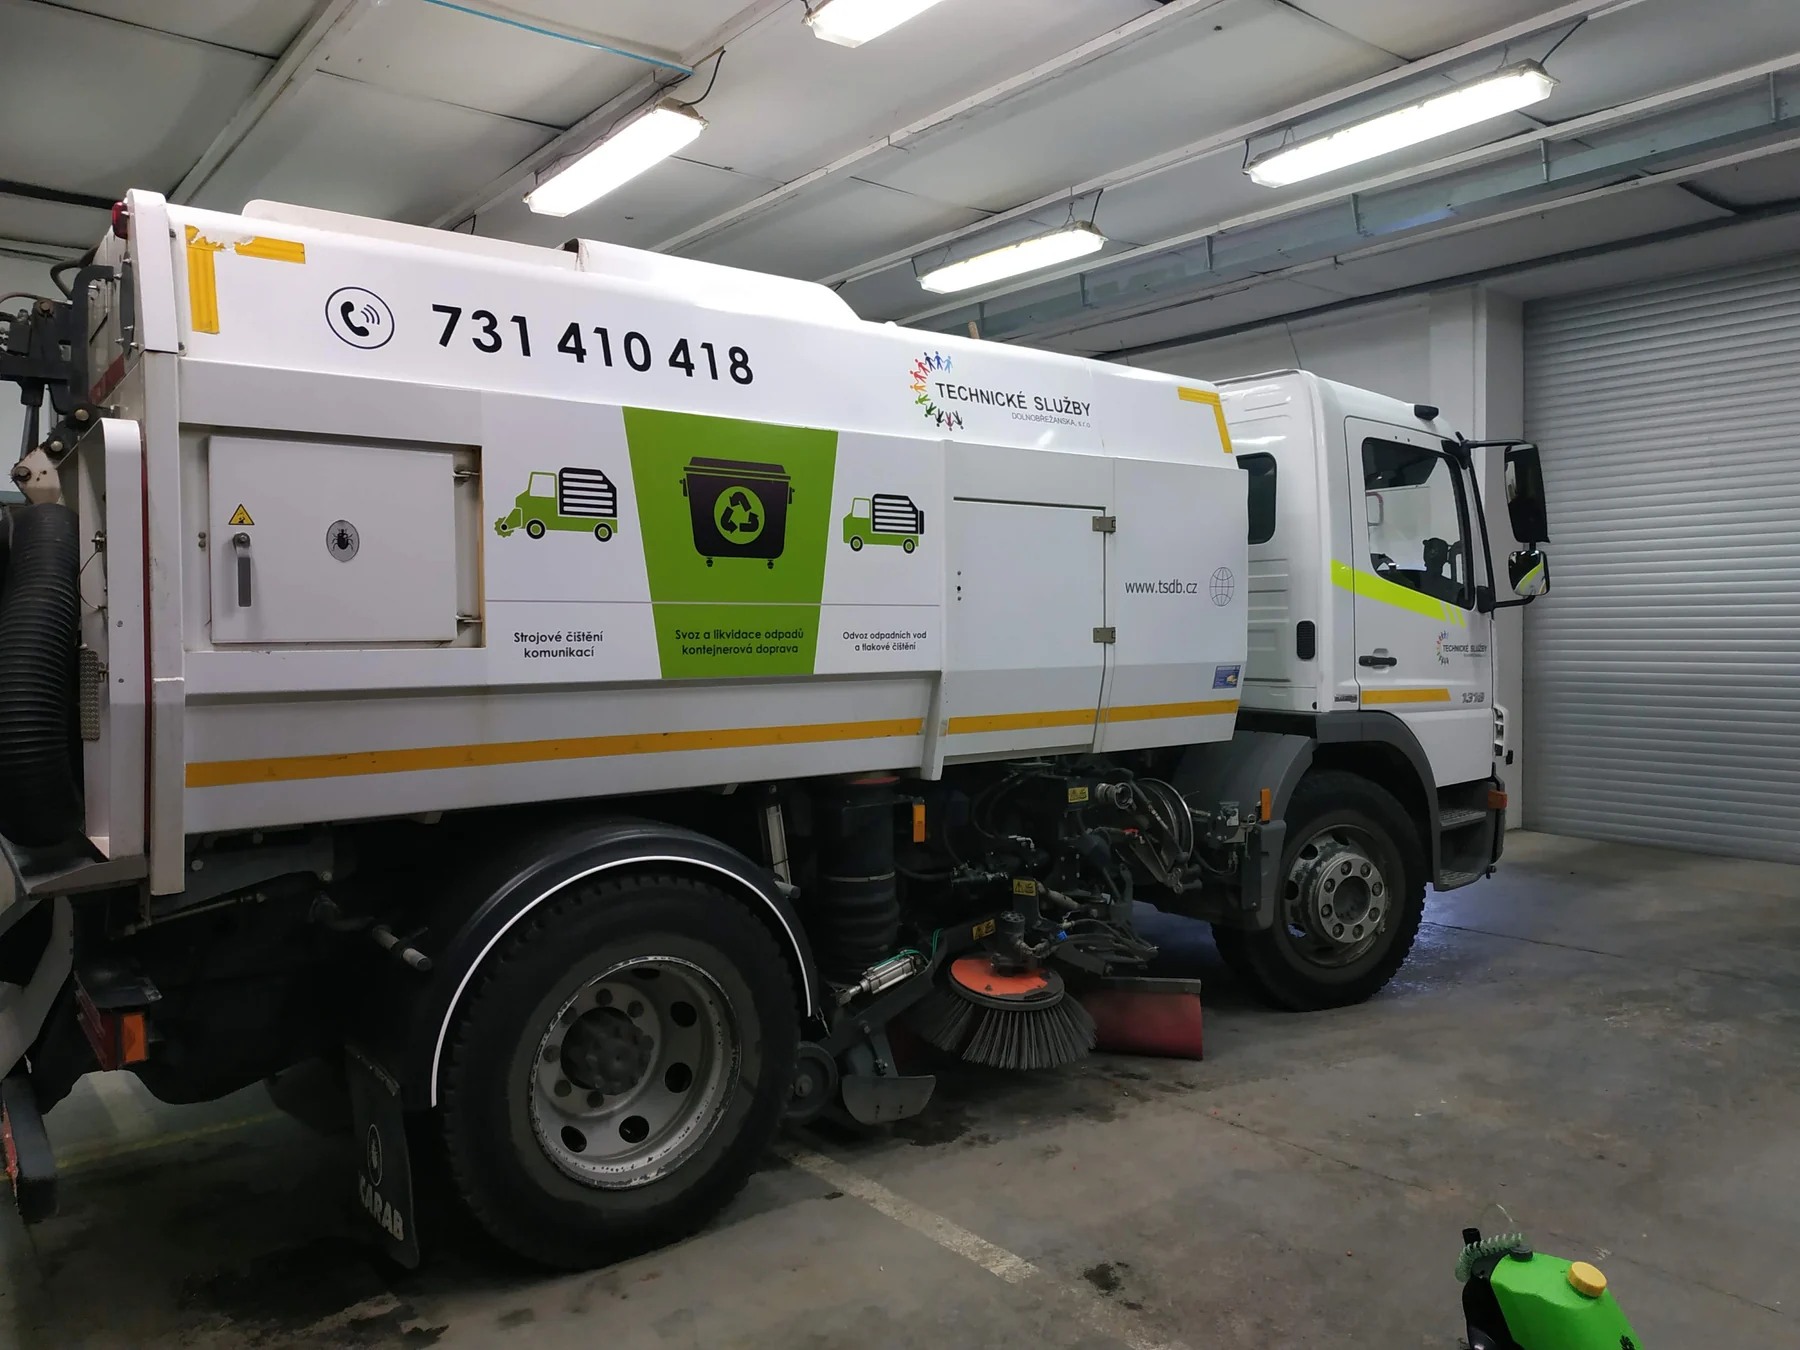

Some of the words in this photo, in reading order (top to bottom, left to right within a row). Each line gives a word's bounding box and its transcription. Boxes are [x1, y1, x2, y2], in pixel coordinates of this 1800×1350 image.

[432, 303, 532, 358] 731
[557, 322, 652, 373] 410
[668, 337, 754, 386] 418
[935, 382, 1028, 410] TECHNICKÉ
[1034, 395, 1091, 417] SLUŽBY
[1125, 579, 1198, 594] www.tsdb.cz
[513, 631, 563, 645] Strojové
[565, 631, 604, 643] čištění
[675, 629, 701, 640] Svoz
[713, 629, 762, 640] likvidace
[764, 628, 804, 641] odpadů
[842, 631, 868, 640] Odvoz
[869, 630, 911, 641] odpadních
[912, 631, 927, 639] vod
[524, 646, 595, 659] komunikací
[682, 643, 753, 657] kontejnerová
[756, 644, 799, 655] doprava
[854, 644, 860, 652] a
[862, 642, 891, 652] tlakové
[892, 642, 917, 651] čištění
[357, 1169, 405, 1242] CARAB
